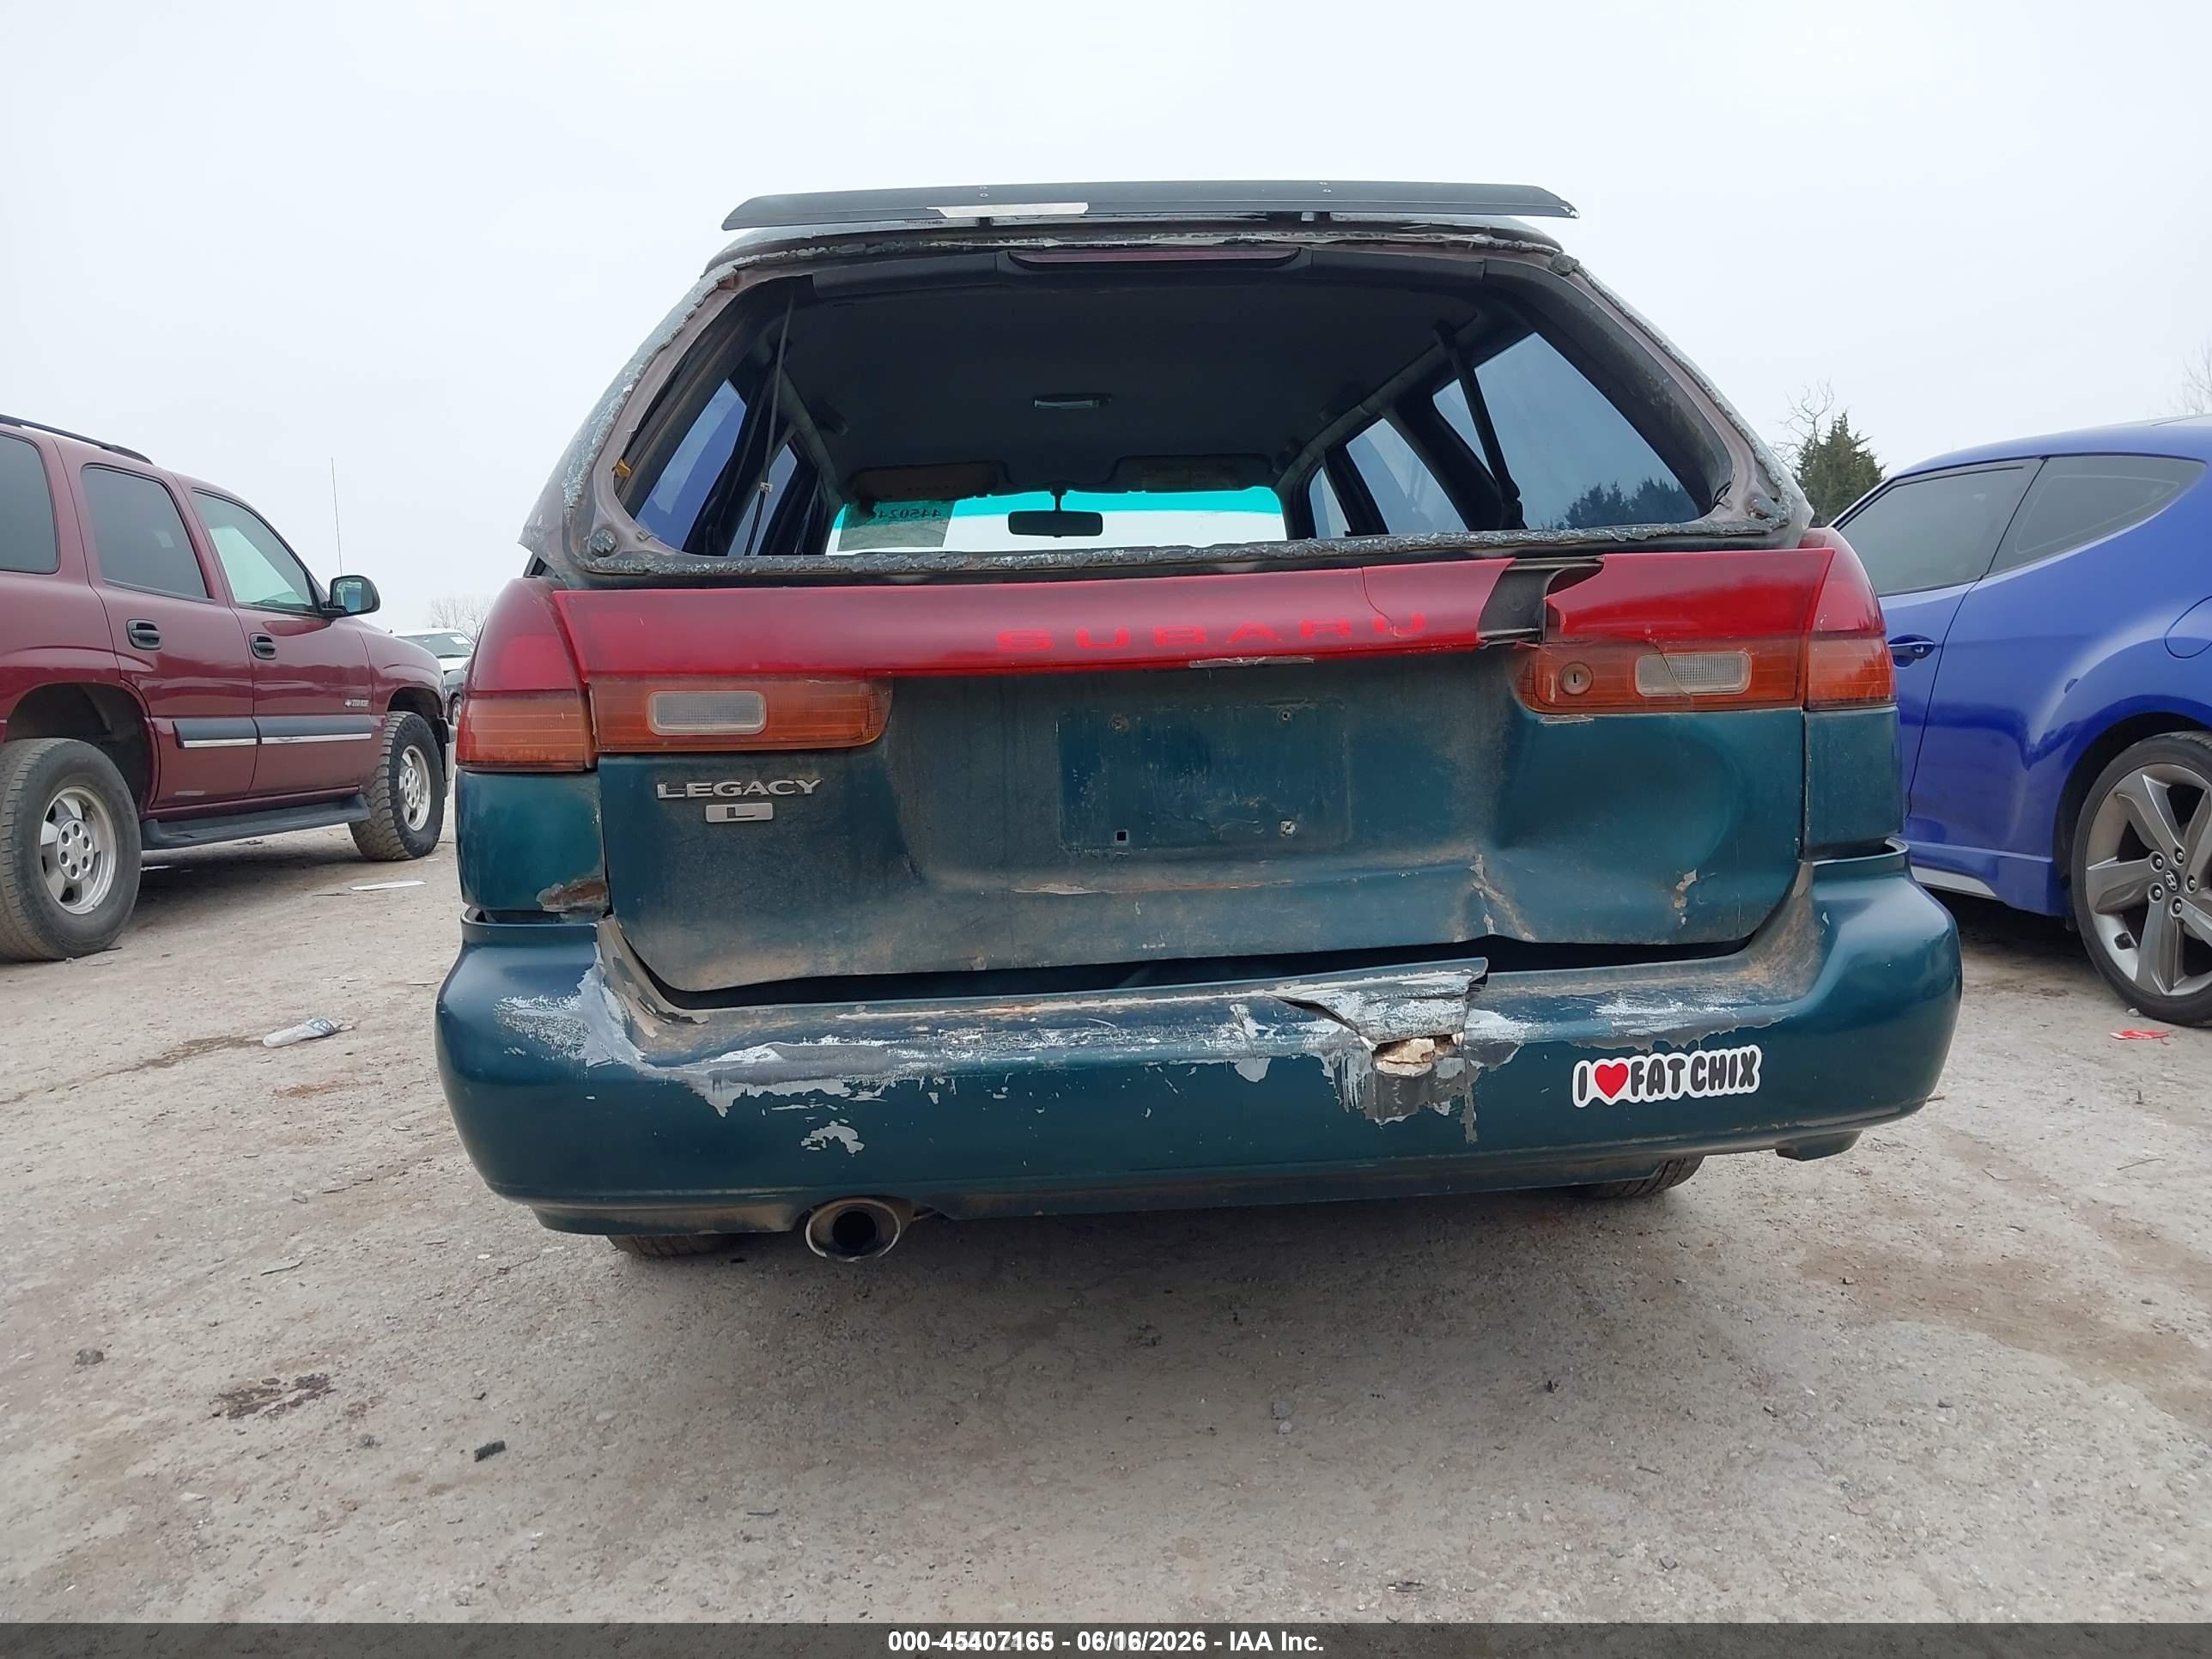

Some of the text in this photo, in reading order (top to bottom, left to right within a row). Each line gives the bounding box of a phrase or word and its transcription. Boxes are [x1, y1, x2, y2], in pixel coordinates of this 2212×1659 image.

[997, 614, 1425, 652] SUBARU
[657, 779, 822, 799] LEGACY
[726, 807, 757, 819] L
[1578, 1050, 1757, 1101] I FAT CHIX
